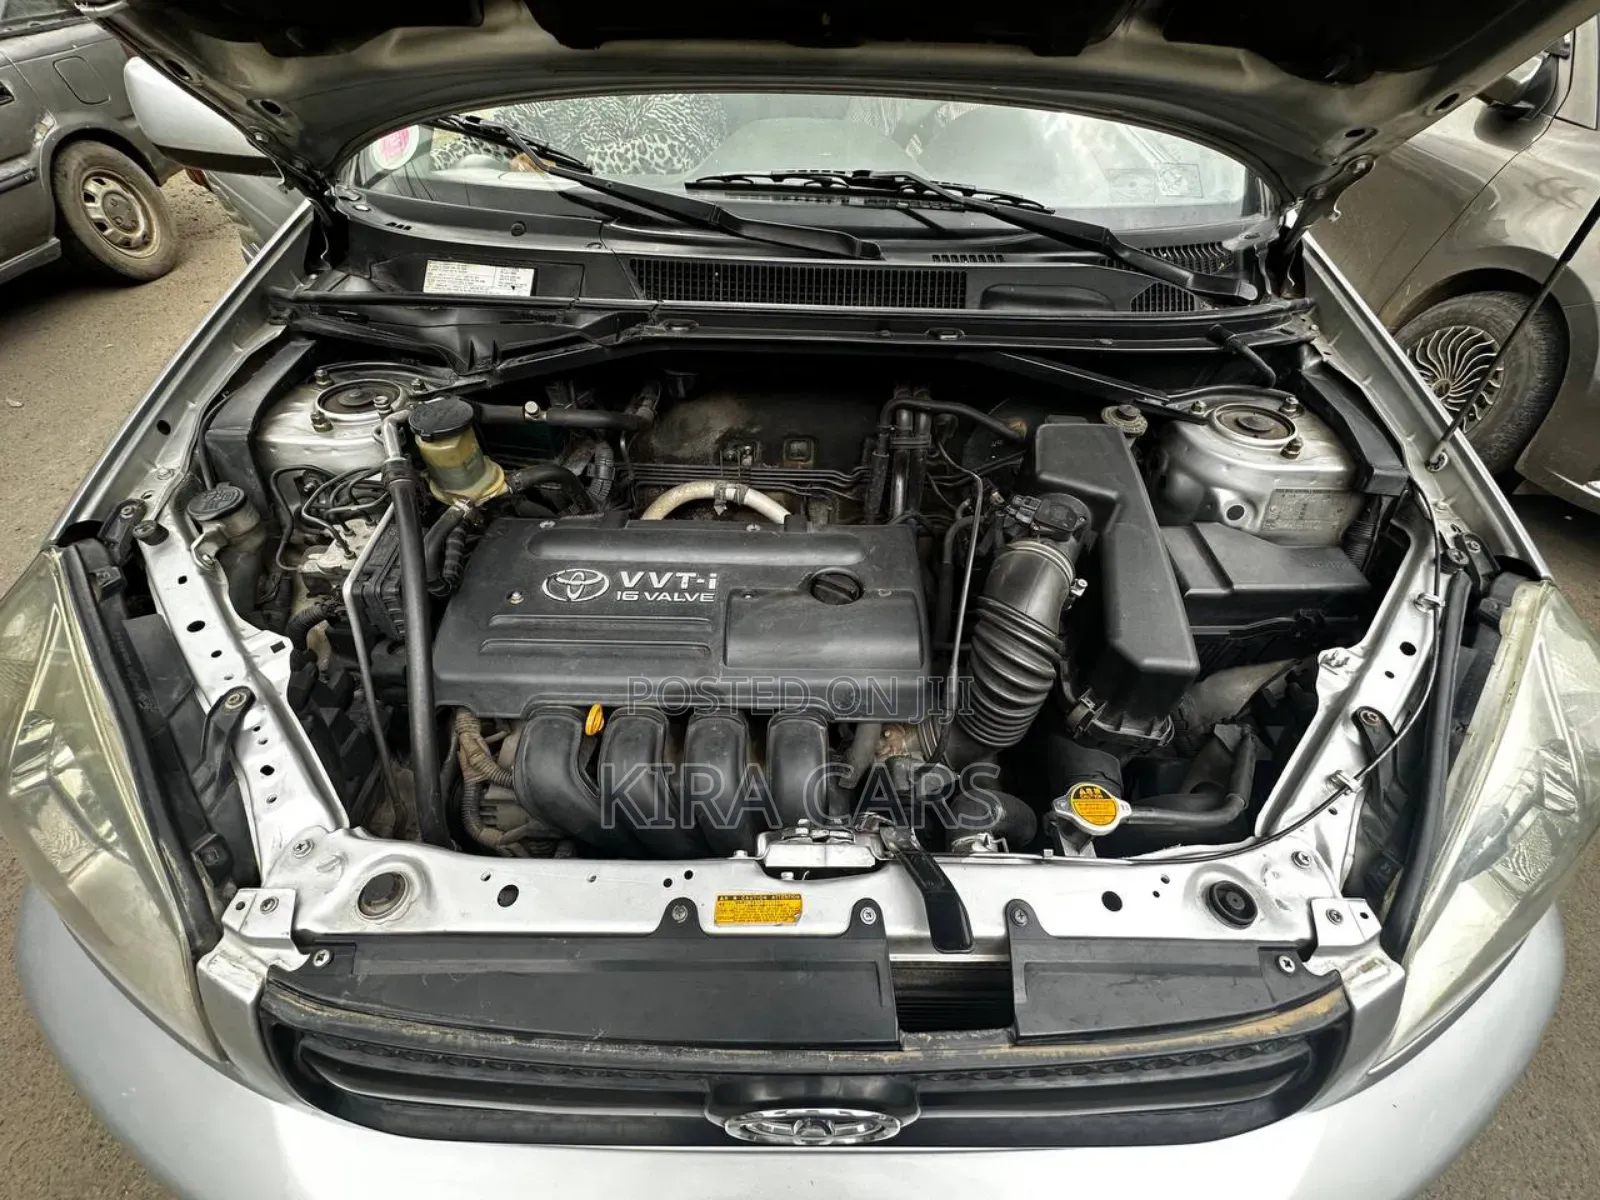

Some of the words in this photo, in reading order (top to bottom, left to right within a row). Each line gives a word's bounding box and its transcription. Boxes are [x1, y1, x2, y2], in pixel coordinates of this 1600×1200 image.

[620, 571, 717, 589] VVT-i
[616, 590, 640, 601] 16
[643, 592, 715, 602] VALVE
